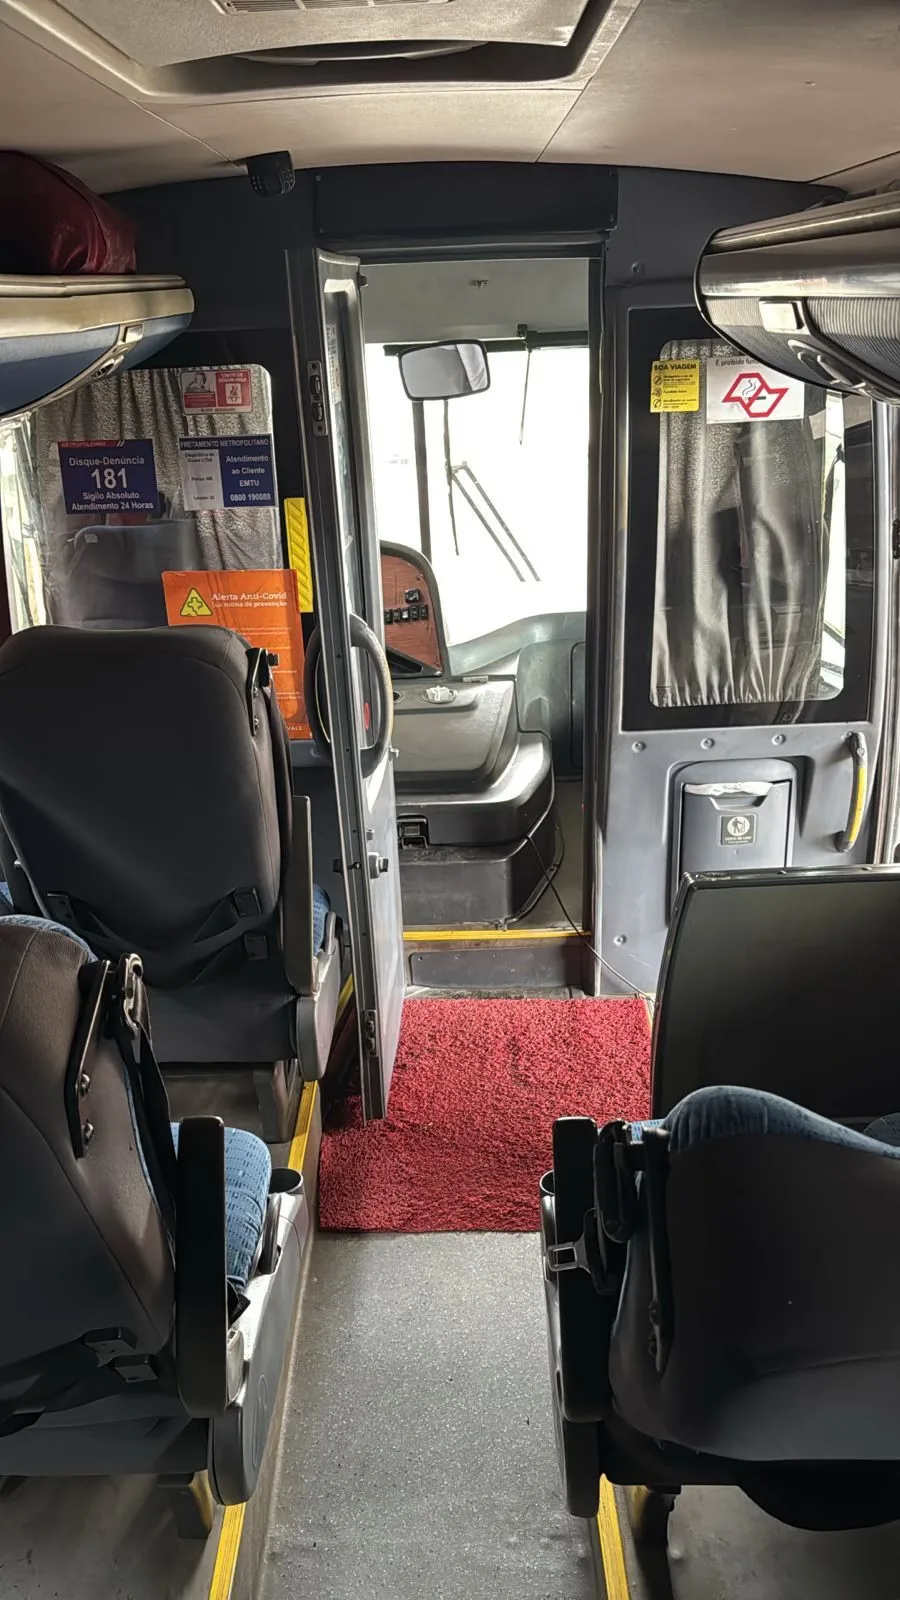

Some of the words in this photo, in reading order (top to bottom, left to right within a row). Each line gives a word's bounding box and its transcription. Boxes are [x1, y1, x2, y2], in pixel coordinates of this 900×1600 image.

[721, 359, 744, 367] proibido
[180, 440, 219, 449] FRETAMENTO
[220, 438, 269, 447] METROPOLITANO
[69, 455, 145, 468] Disque-Denúncia
[225, 455, 269, 463] Atendimento
[91, 467, 128, 489] 181
[239, 479, 260, 487] EMTU
[82, 491, 105, 502] Sigilo
[105, 491, 140, 499] Absoluto
[229, 493, 246, 501] 0800
[71, 502, 119, 511] Atendimento
[120, 501, 130, 510] 24
[131, 501, 154, 509] Horas
[211, 592, 239, 601] Alerta
[240, 591, 287, 601] Anti-Covid
[253, 601, 288, 609] prevenção
